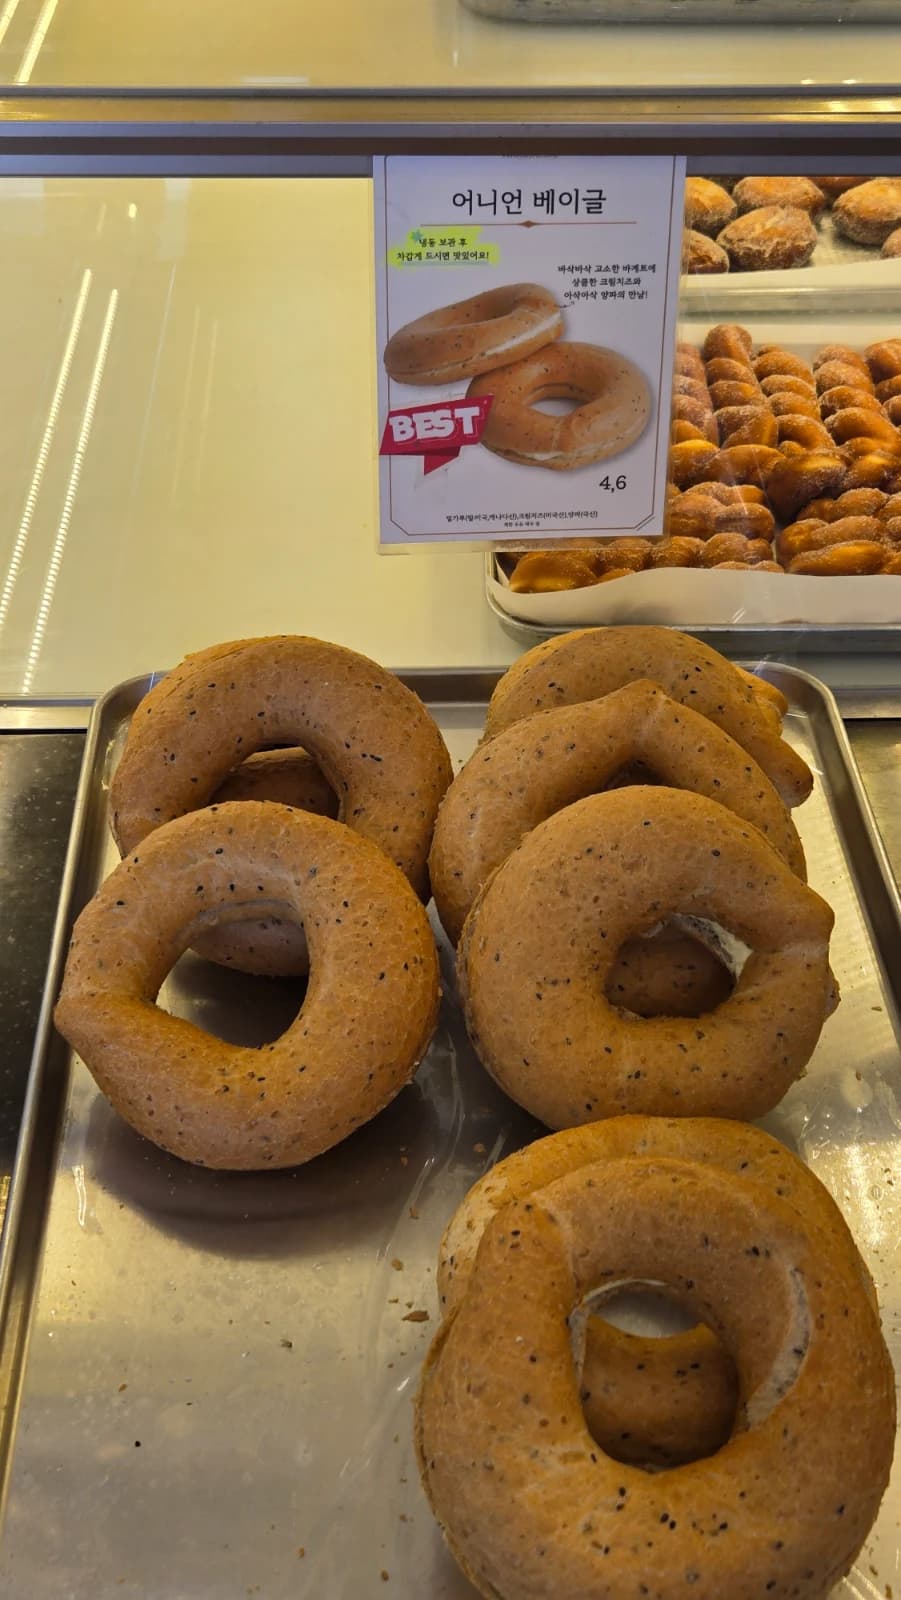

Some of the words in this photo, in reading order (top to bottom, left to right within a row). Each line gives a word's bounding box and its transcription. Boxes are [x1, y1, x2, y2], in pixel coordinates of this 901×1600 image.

[452, 189, 523, 216] 어니언
[533, 188, 607, 215] 베이글
[418, 237, 436, 248] 냉동
[439, 237, 456, 248] 보관
[459, 237, 468, 248] 후
[396, 251, 423, 262] 차갑게
[425, 251, 450, 261] 드시면
[557, 264, 592, 274] 바삭바삭
[594, 264, 620, 274] 고소한
[622, 263, 656, 274] 바게트에
[599, 277, 641, 287] 크림치즈와
[563, 290, 597, 301] 아삭아삭
[600, 290, 625, 300] 양파의
[389, 406, 480, 442] BEST
[599, 475, 627, 493] 4,6
